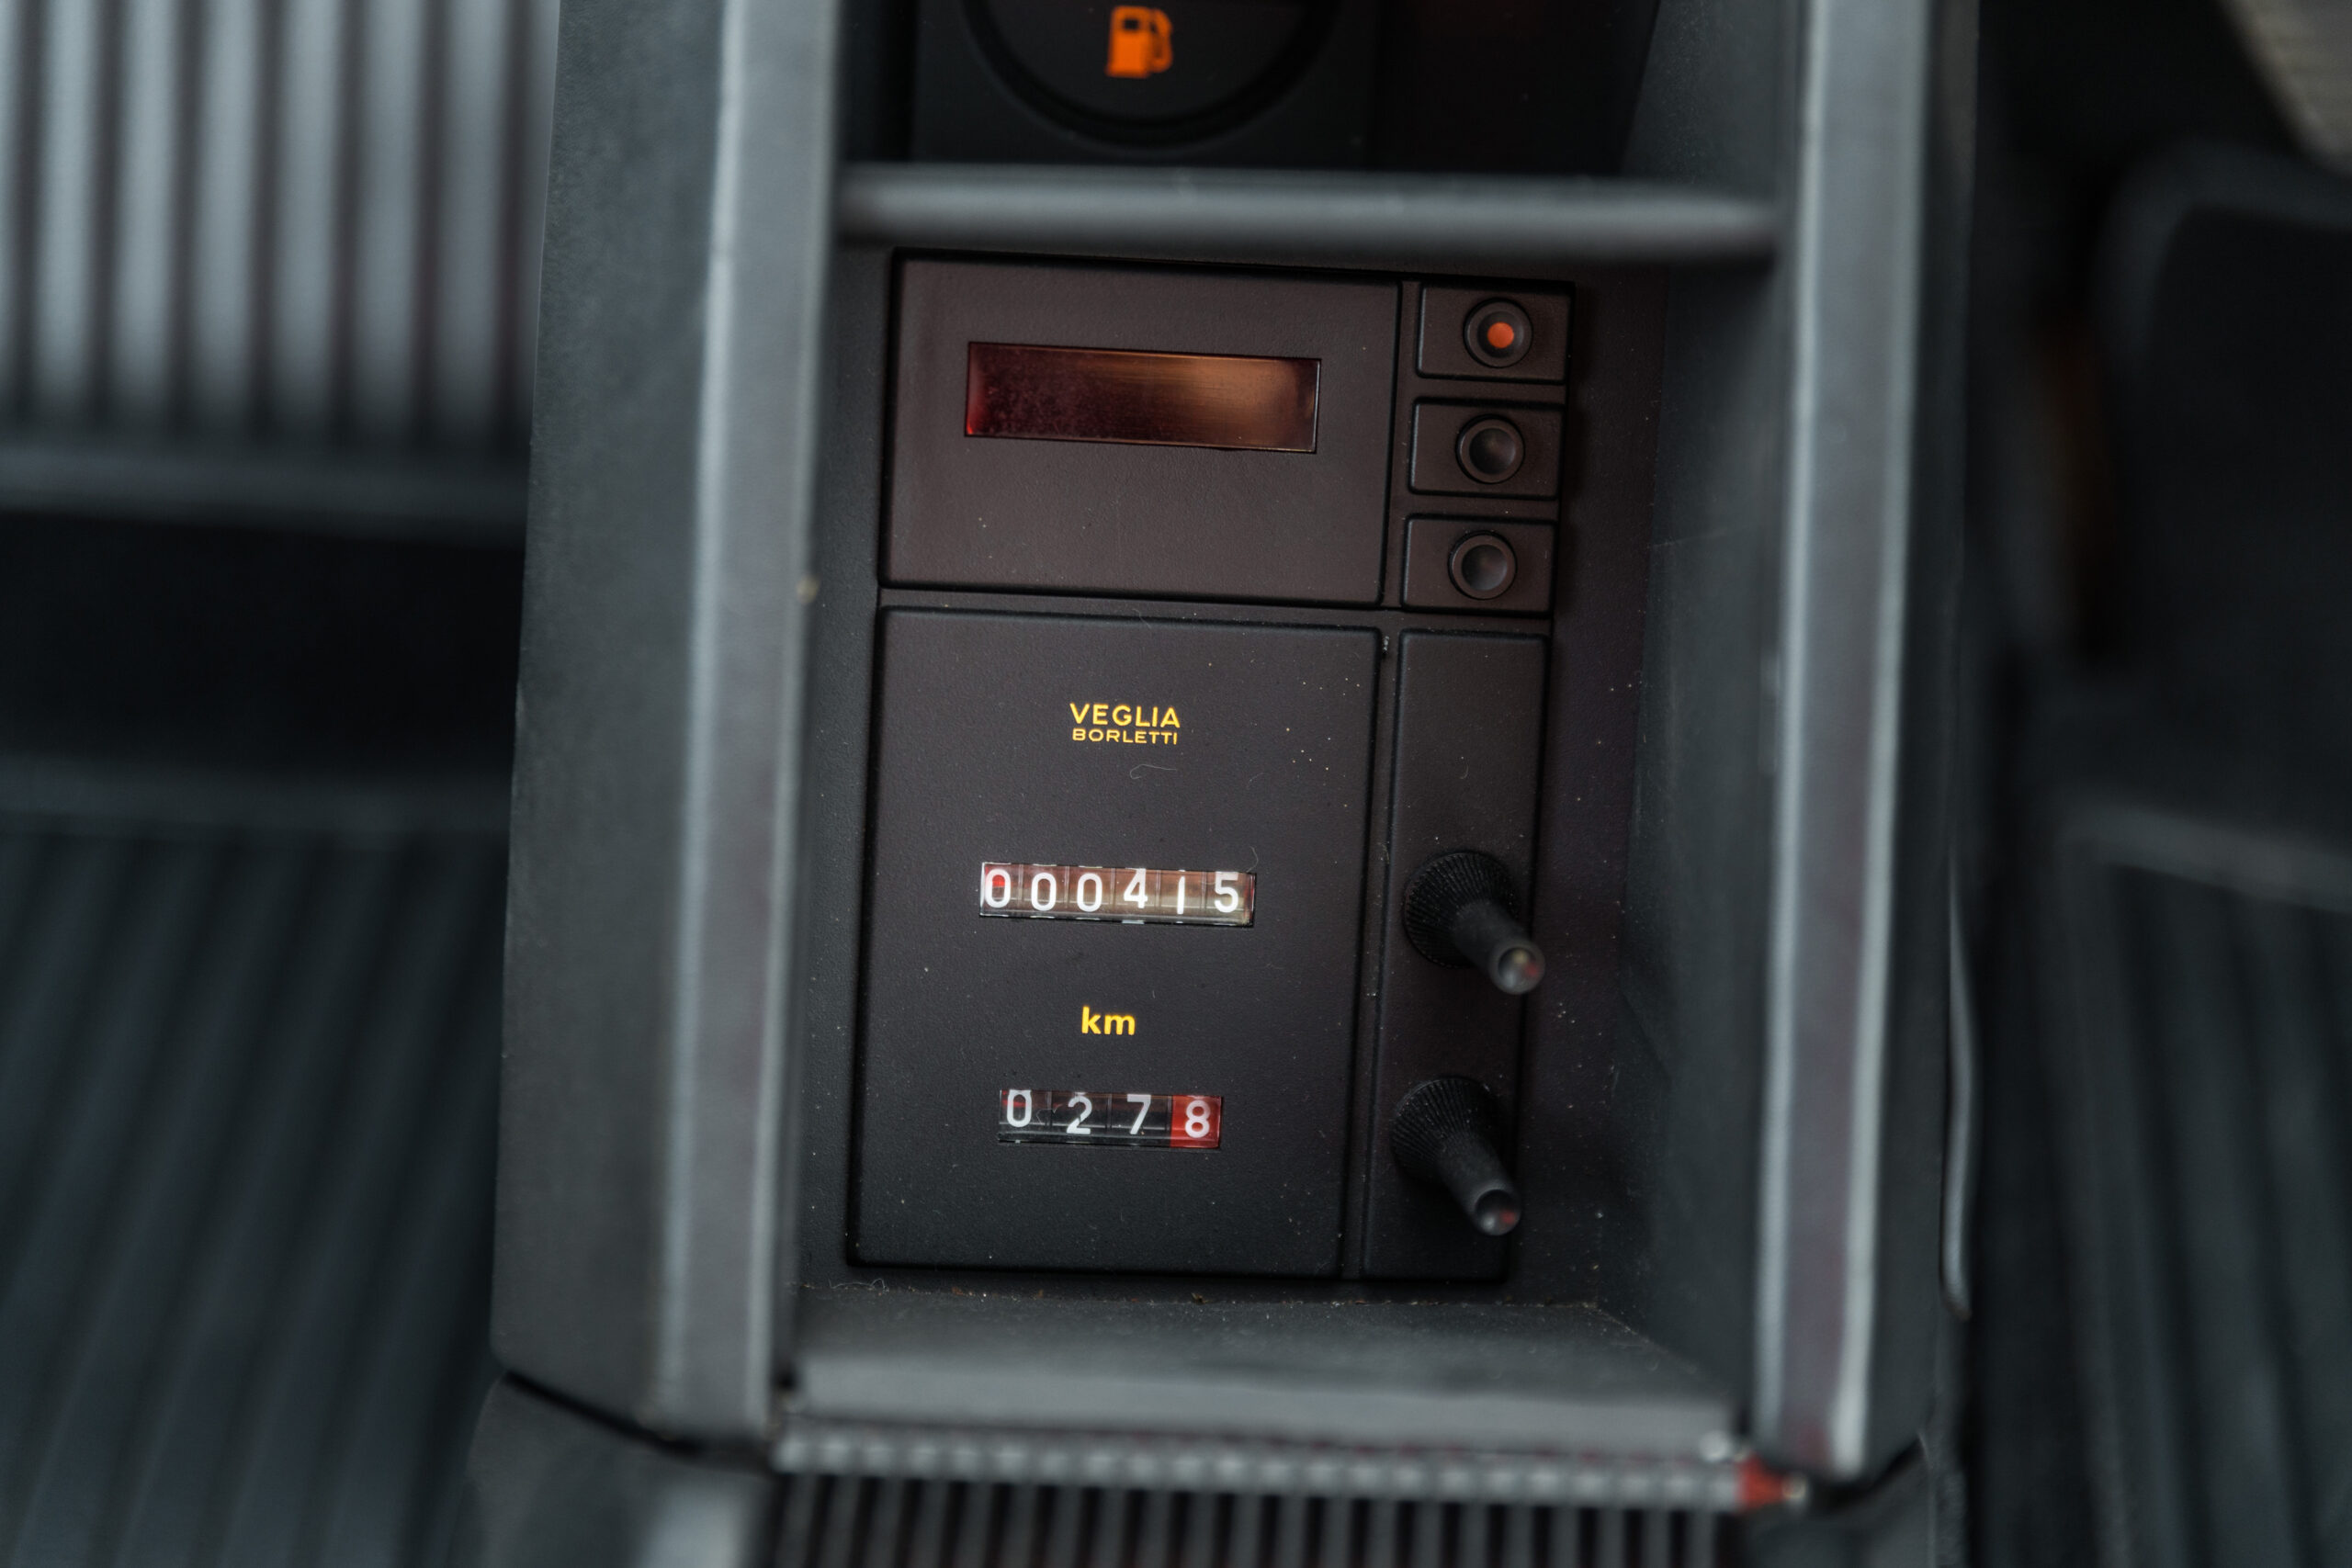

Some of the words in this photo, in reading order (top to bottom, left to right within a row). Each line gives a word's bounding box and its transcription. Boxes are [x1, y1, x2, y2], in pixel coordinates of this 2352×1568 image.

[1069, 703, 1181, 728] VEGLIA
[1072, 728, 1178, 745] BORLETTI
[1081, 1006, 1136, 1035] km
[1006, 1089, 1211, 1138] 0278
